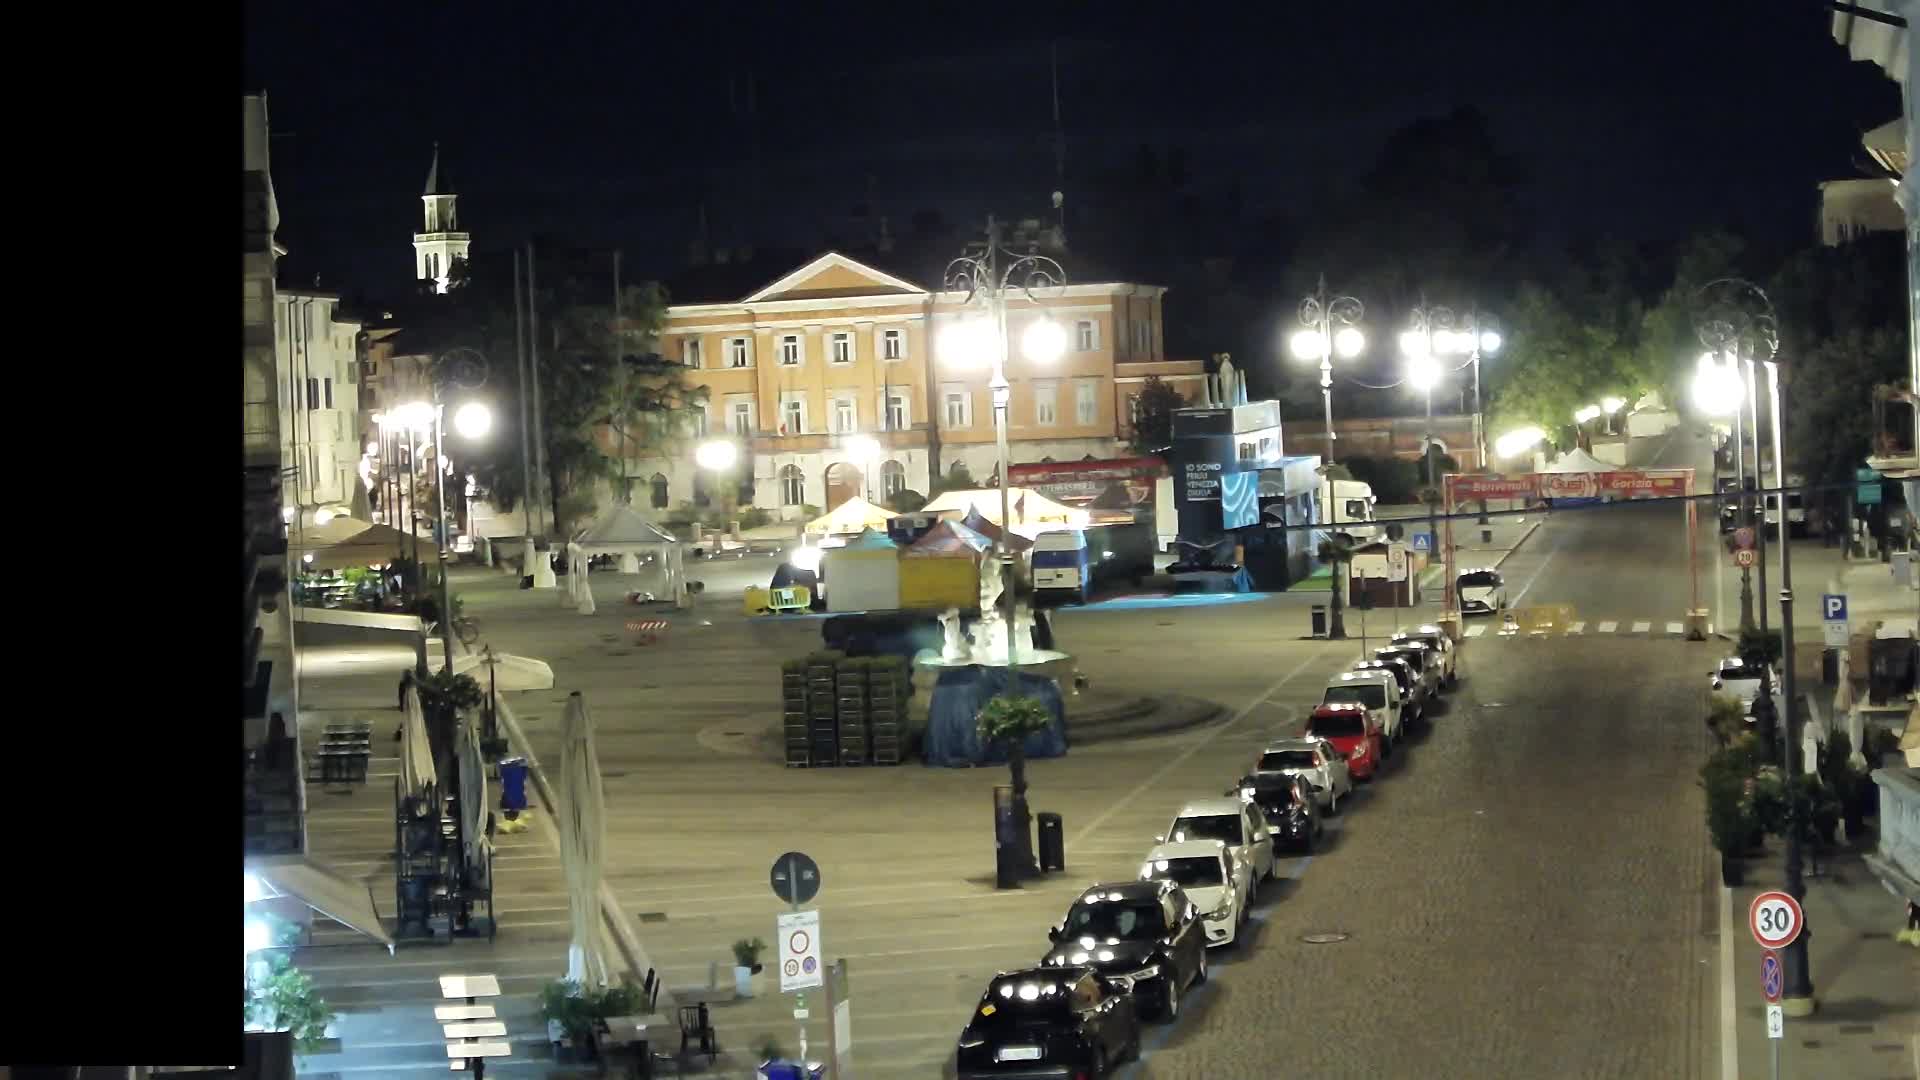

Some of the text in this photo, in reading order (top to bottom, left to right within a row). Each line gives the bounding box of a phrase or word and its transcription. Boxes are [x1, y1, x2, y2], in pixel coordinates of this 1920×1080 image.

[1196, 463, 1221, 471] SONO
[1828, 598, 1842, 617] P
[1760, 907, 1790, 932] 30
